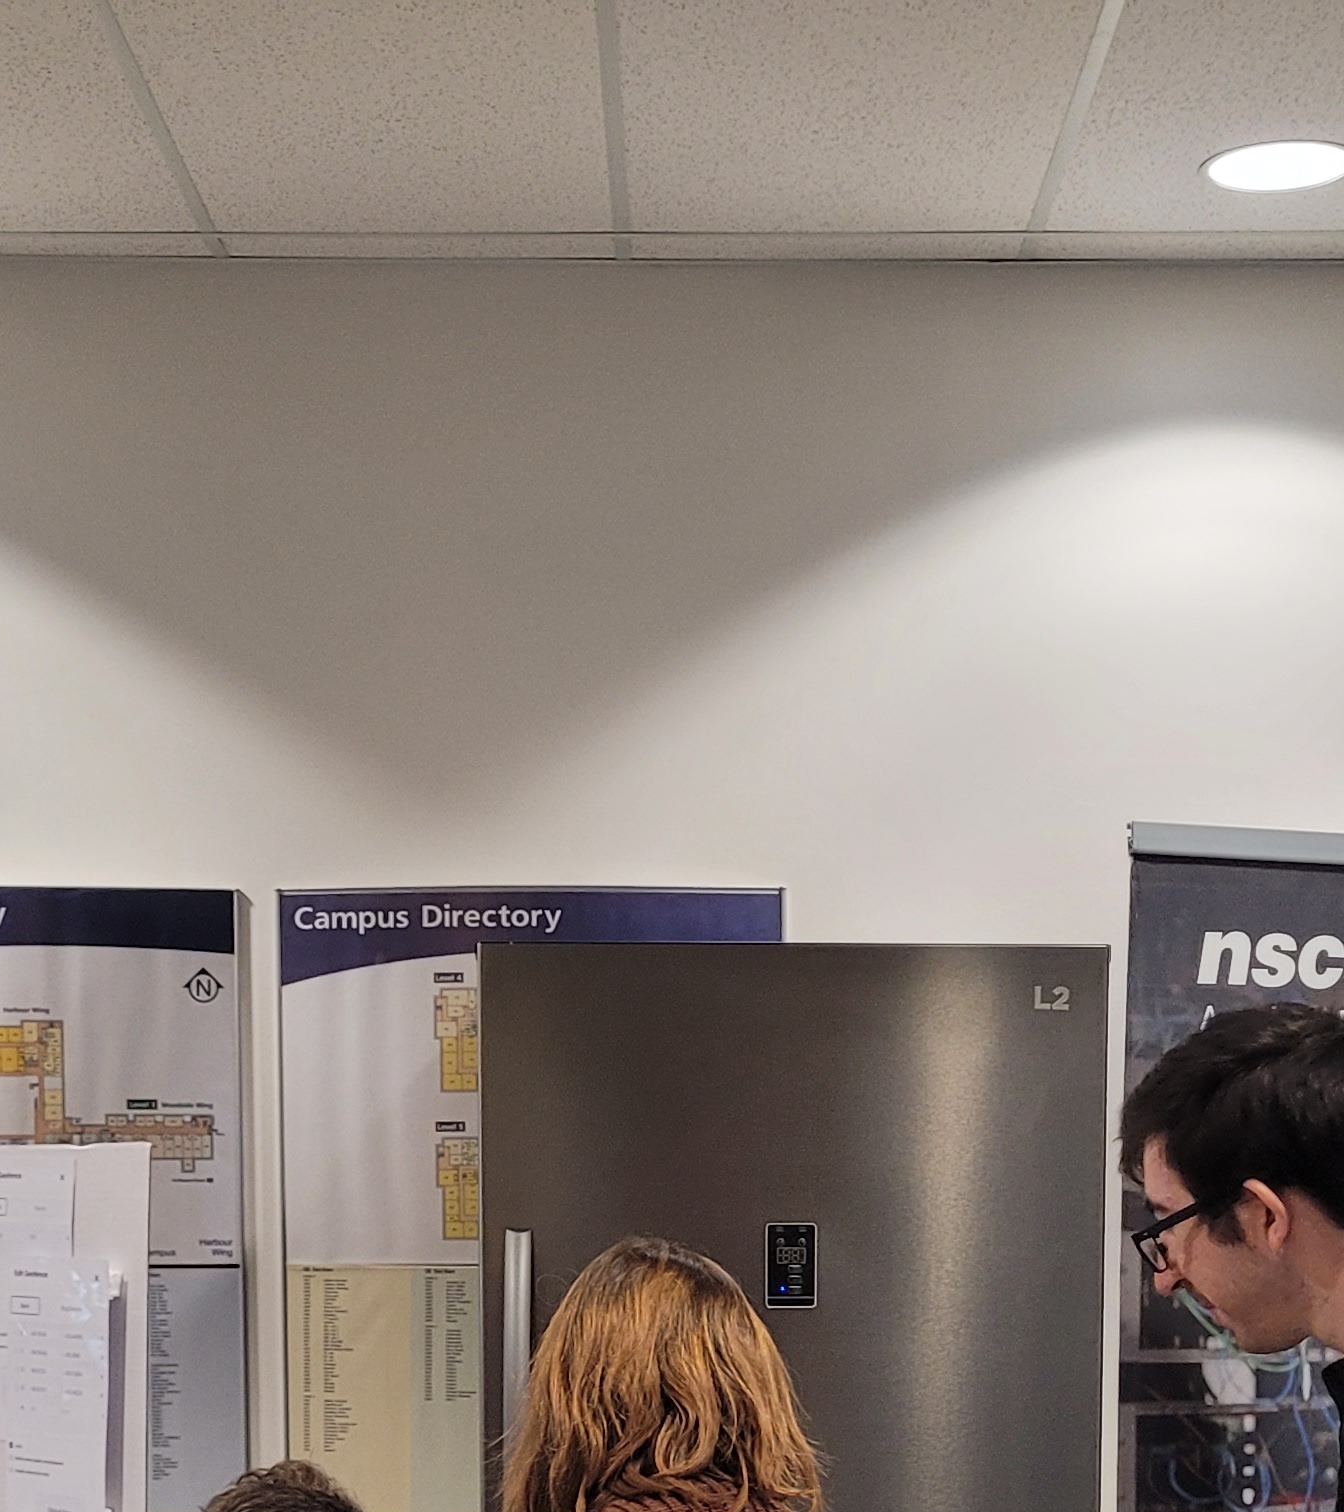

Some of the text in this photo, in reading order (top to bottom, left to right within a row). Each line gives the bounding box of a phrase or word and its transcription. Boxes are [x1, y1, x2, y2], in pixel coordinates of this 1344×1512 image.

[294, 903, 562, 935] Campus Directory
[1033, 985, 1070, 1011] L2
